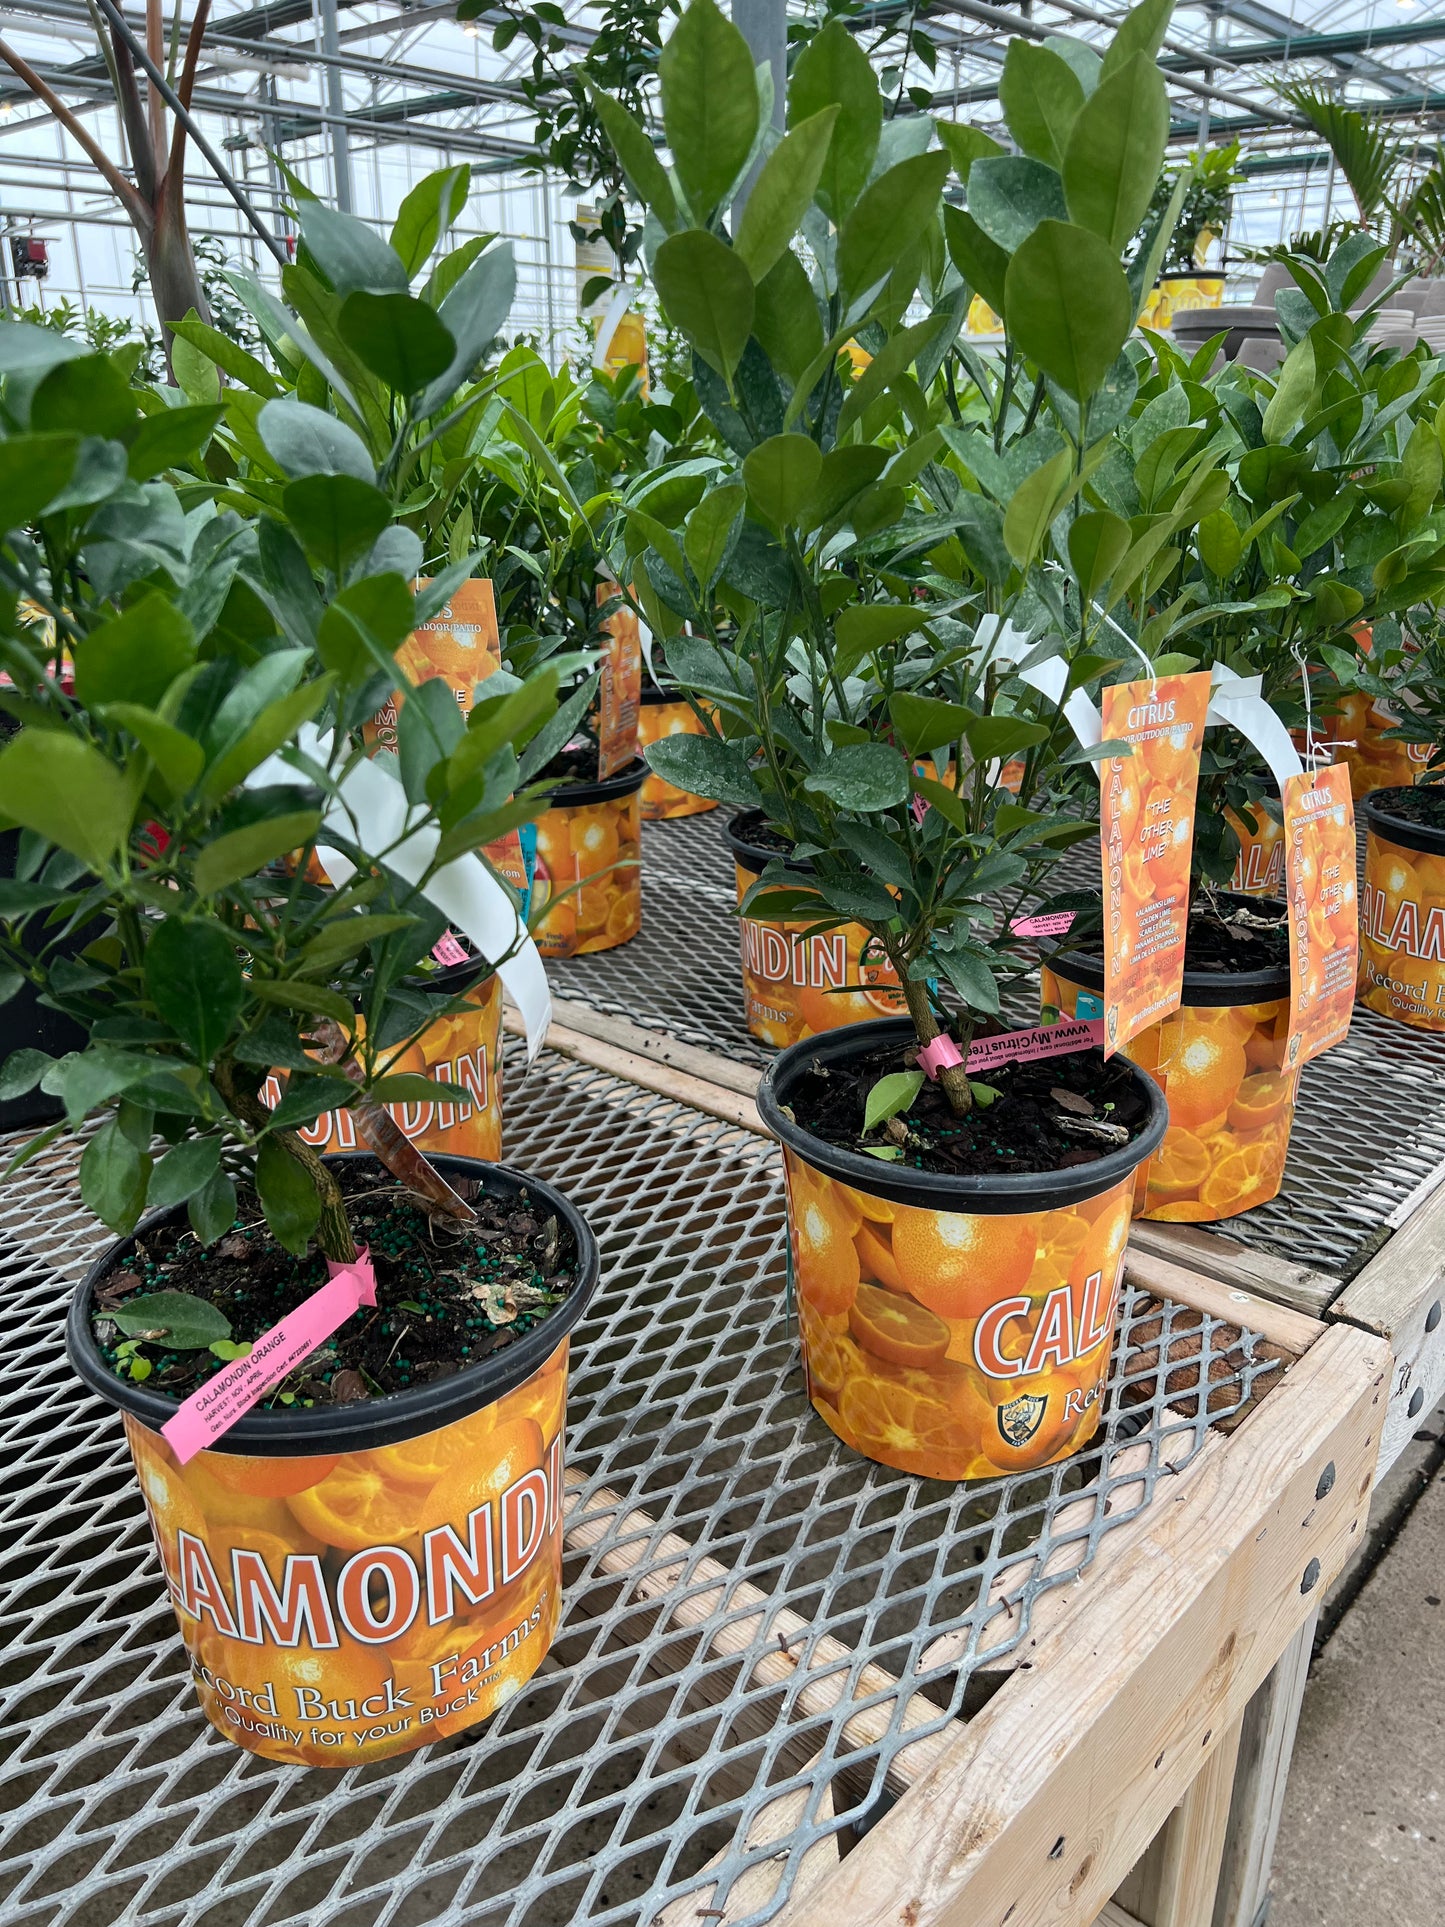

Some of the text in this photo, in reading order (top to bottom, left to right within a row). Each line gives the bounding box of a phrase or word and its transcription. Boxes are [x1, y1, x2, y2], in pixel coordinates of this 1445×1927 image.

[1127, 699, 1176, 729] CITRUS
[1301, 786, 1332, 811] CITRUS
[1140, 819, 1174, 843] OTHER
[1109, 755, 1124, 978] CALAMONDIN
[1164, 895, 1176, 906] LIME
[1320, 882, 1344, 903] OTHER
[1029, 913, 1070, 924] CALAMONDIN
[1159, 908, 1172, 918] LIME
[1159, 918, 1172, 929] LIME
[1293, 827, 1310, 1011] CALAMONDIN
[1365, 959, 1428, 1001] Record
[195, 1331, 287, 1412] CALAMONDIN ORANGE
[231, 1384, 244, 1398] NOV
[246, 1369, 264, 1385] APRIL
[237, 1393, 252, 1409] Stock
[251, 1371, 277, 1396] Inspection
[294, 1677, 415, 1722] Buck
[310, 1726, 344, 1746] for
[352, 1715, 411, 1747] your
